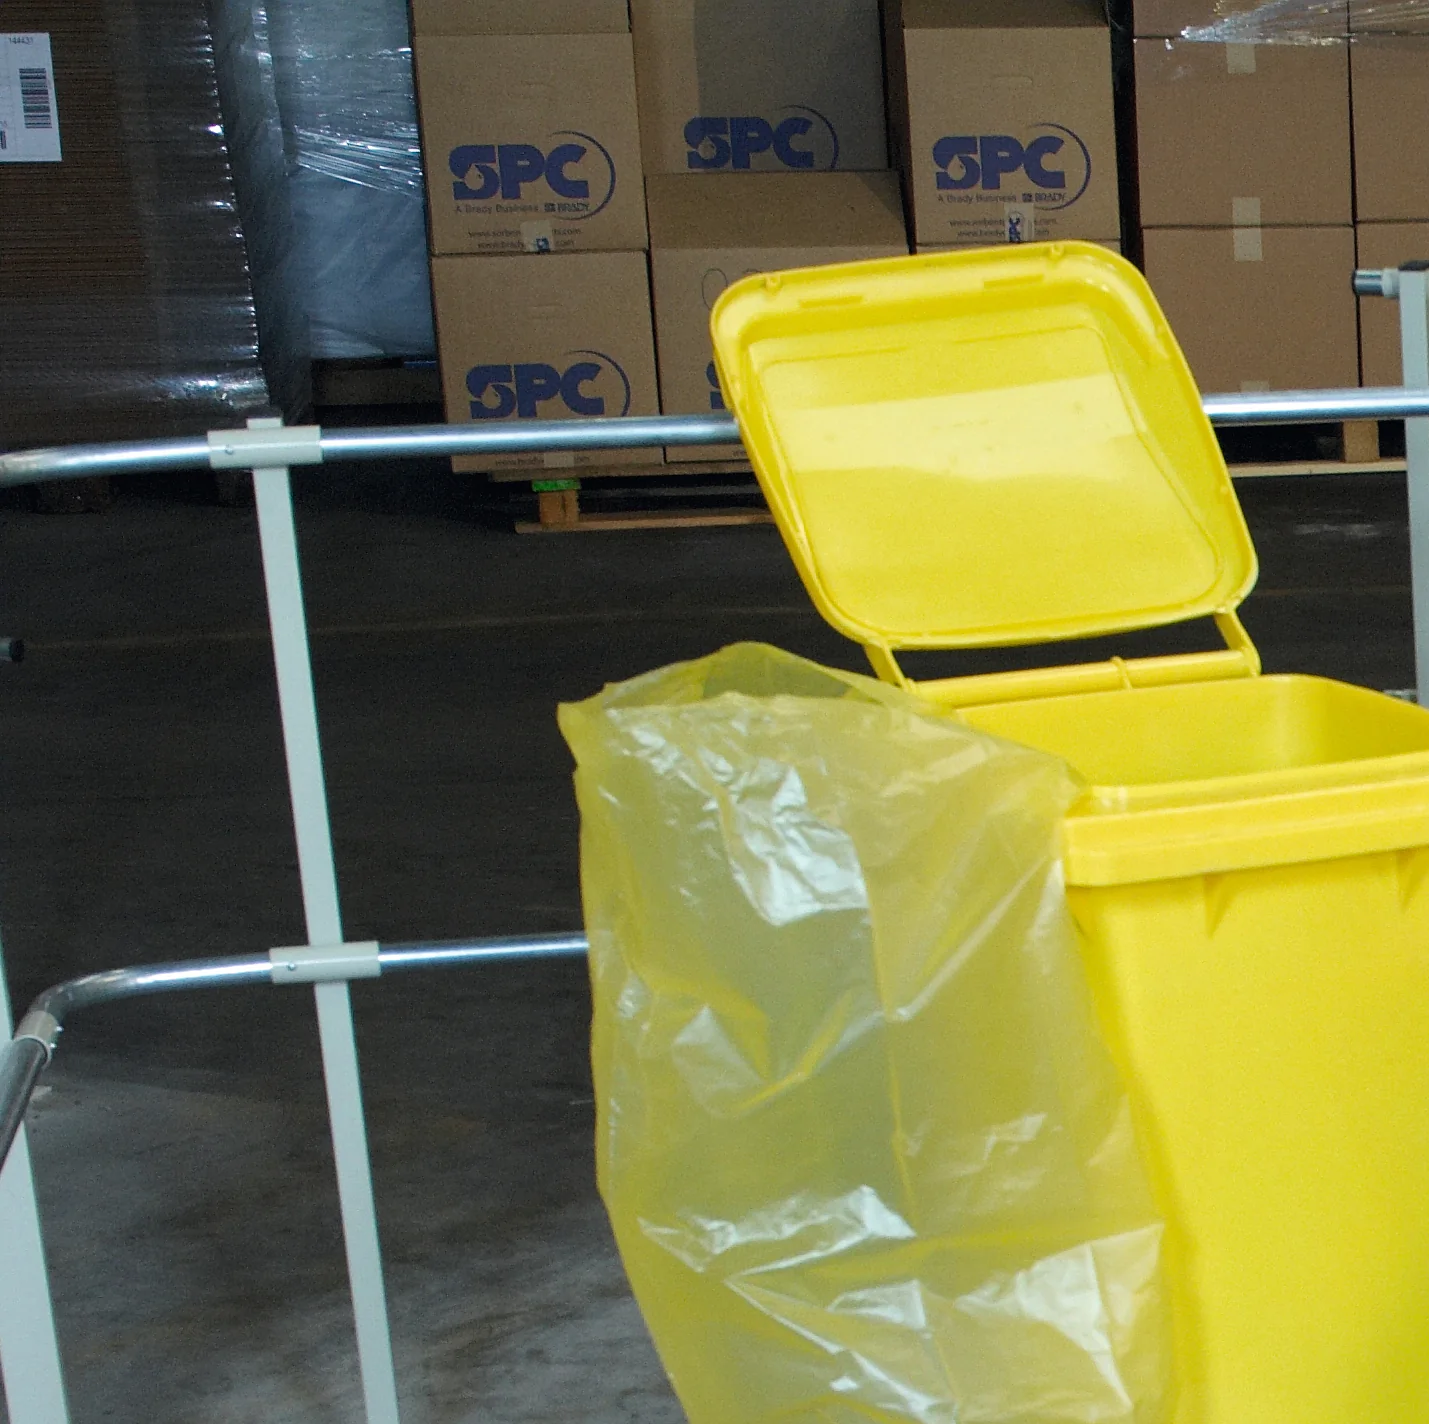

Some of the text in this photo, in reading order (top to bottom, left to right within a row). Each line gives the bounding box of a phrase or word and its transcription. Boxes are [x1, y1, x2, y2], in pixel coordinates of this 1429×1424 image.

[684, 116, 815, 169] SPC
[932, 135, 1066, 190] SPC
[449, 144, 590, 200] SPC
[466, 362, 605, 419] SPC
